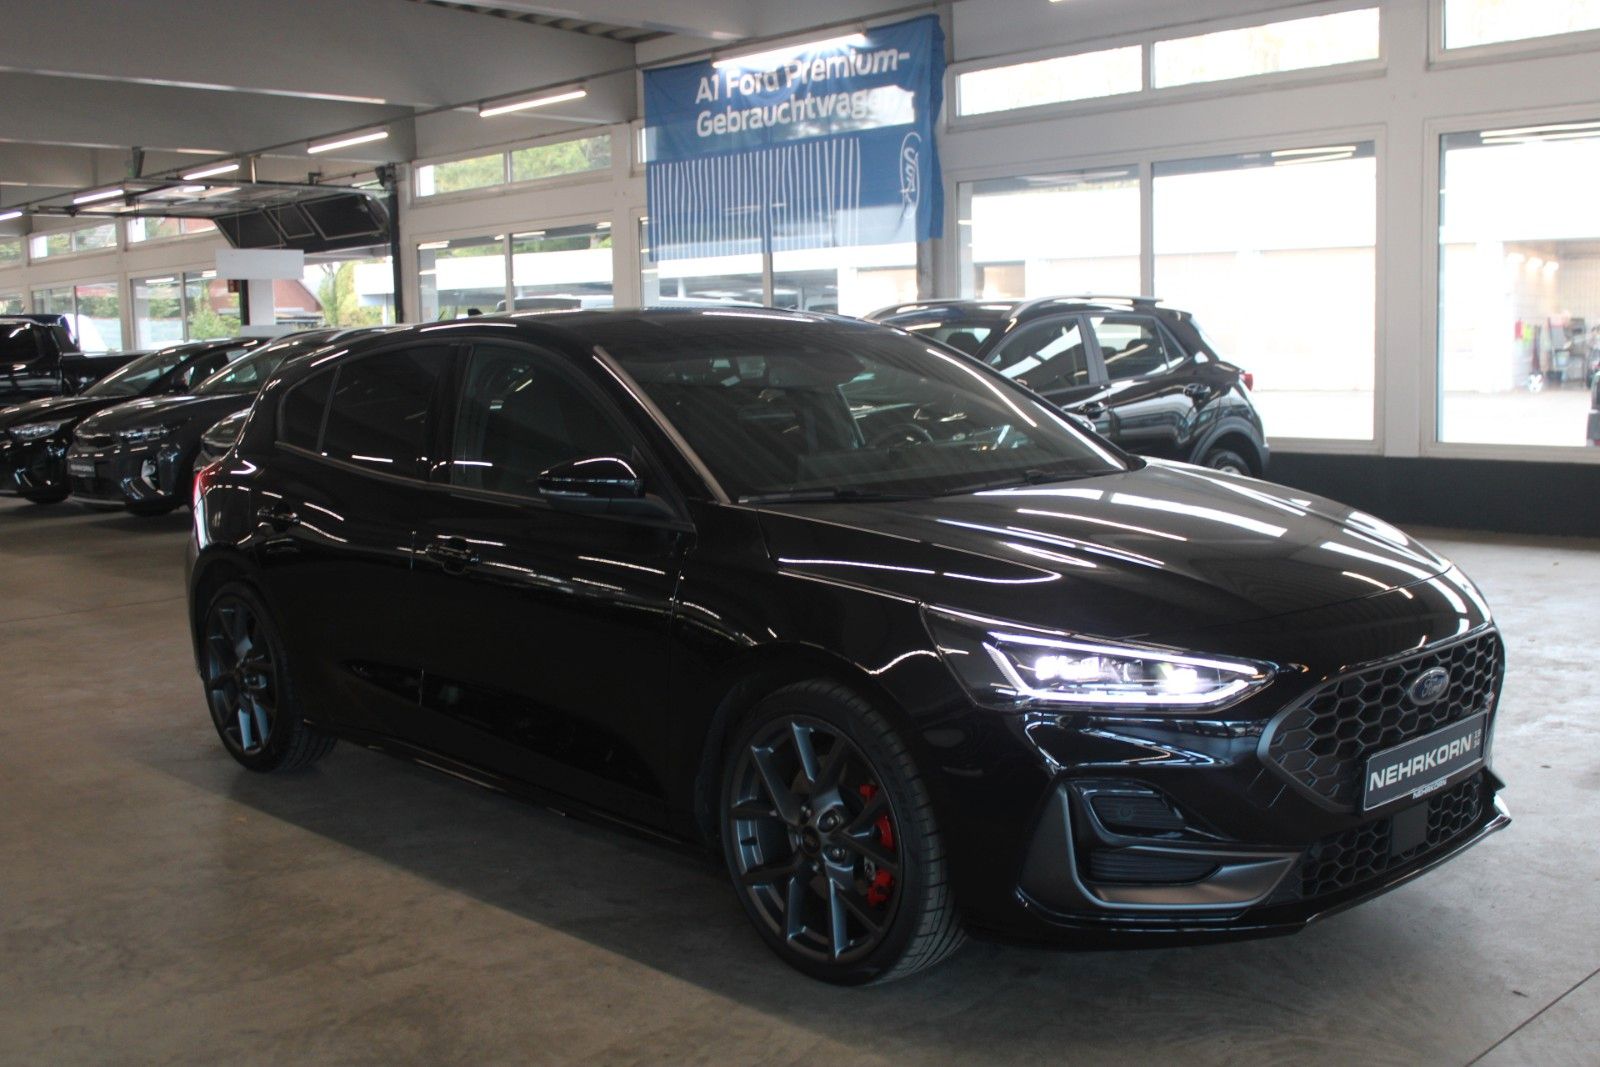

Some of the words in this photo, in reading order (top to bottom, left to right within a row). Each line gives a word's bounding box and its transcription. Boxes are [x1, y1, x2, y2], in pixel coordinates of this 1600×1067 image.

[725, 64, 779, 98] Ford
[785, 48, 910, 88] Premium-
[696, 86, 915, 137] Gebrauchtwag
[1369, 733, 1472, 791] NEHRKORN
